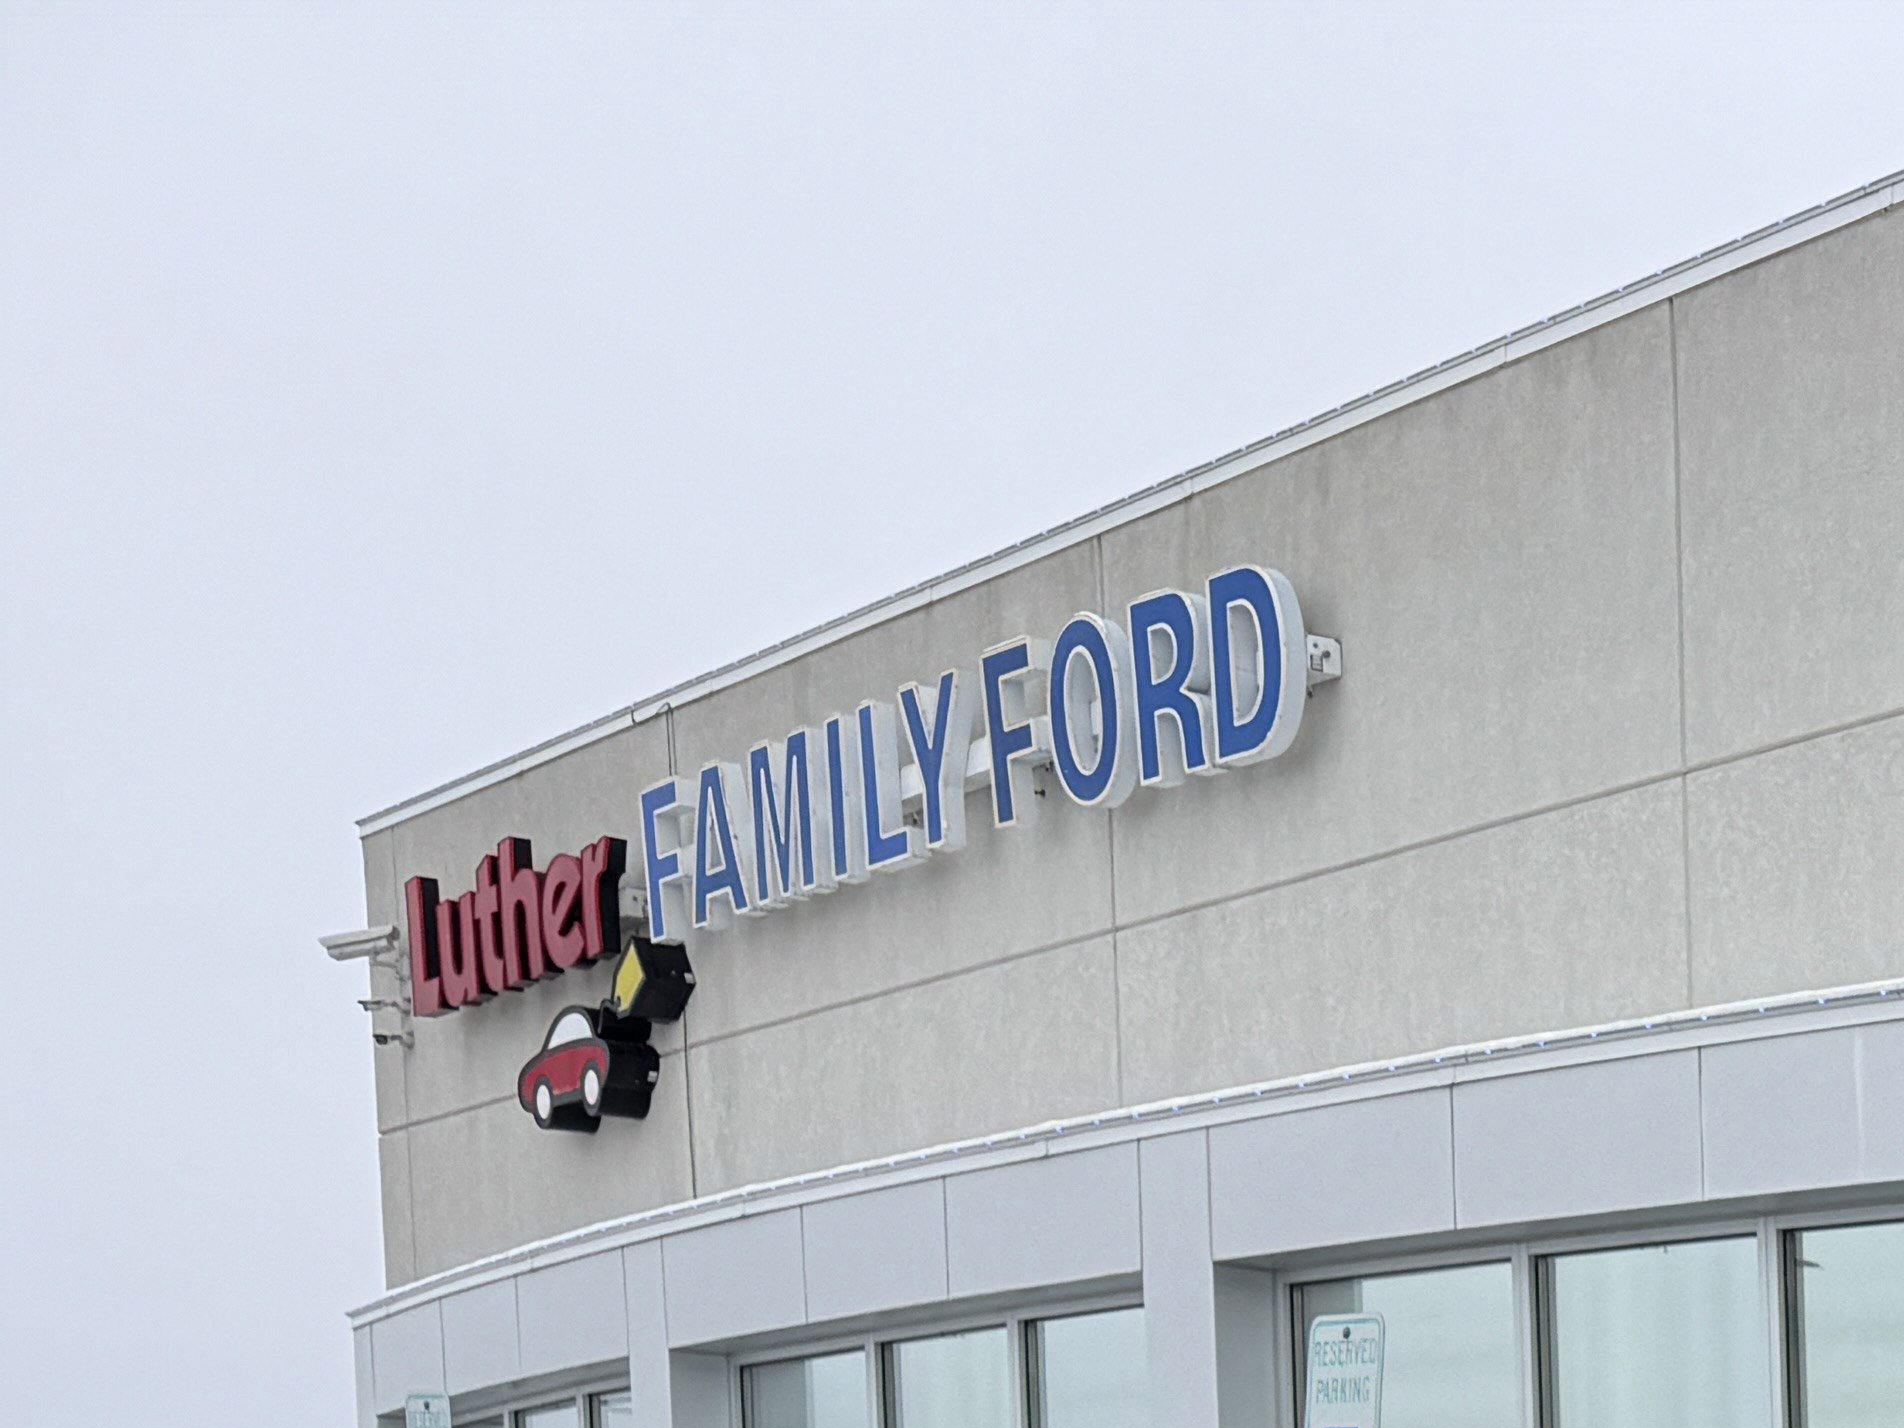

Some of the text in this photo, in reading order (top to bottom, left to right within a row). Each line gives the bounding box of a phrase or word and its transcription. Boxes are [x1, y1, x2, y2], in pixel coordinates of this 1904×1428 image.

[639, 563, 1303, 943] FAMILY FORD
[404, 835, 626, 1017] Luther
[1316, 1376, 1370, 1404] PARKING
